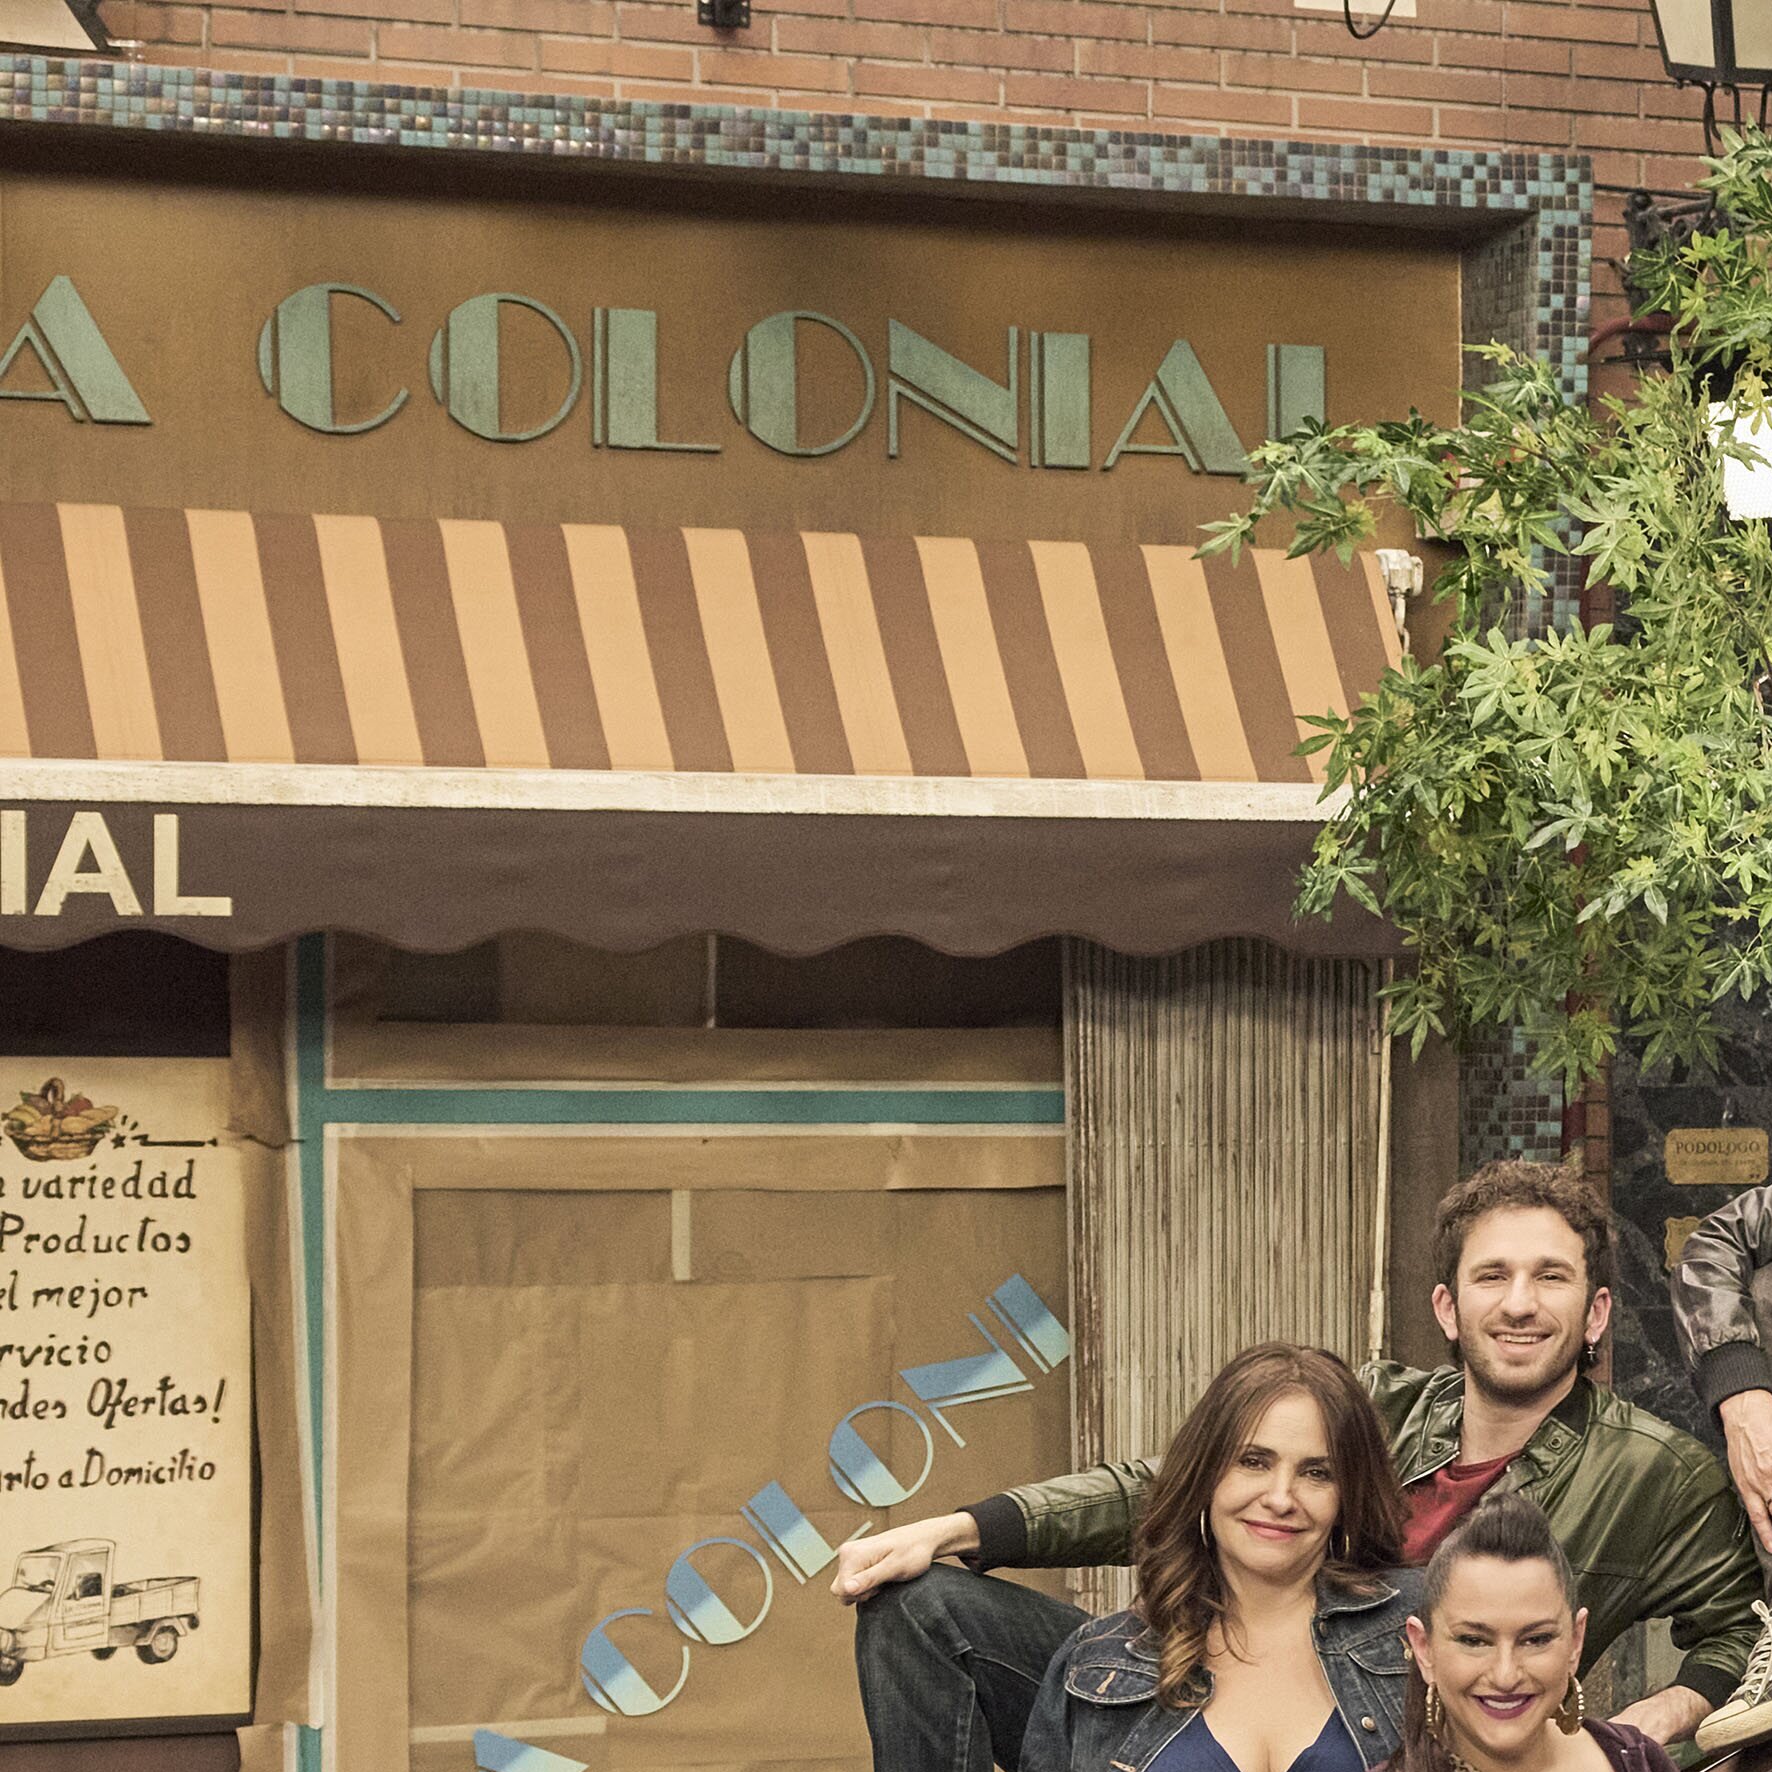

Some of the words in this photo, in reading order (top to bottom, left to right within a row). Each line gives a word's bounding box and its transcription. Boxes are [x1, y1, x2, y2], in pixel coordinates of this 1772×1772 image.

[22, 1158, 197, 1200] variedad
[0, 1211, 192, 1254] Productos
[32, 1278, 148, 1319] mejor
[86, 1375, 226, 1430] Ofertas!
[57, 1469, 73, 1488] a
[79, 1447, 216, 1488] Domicilio
